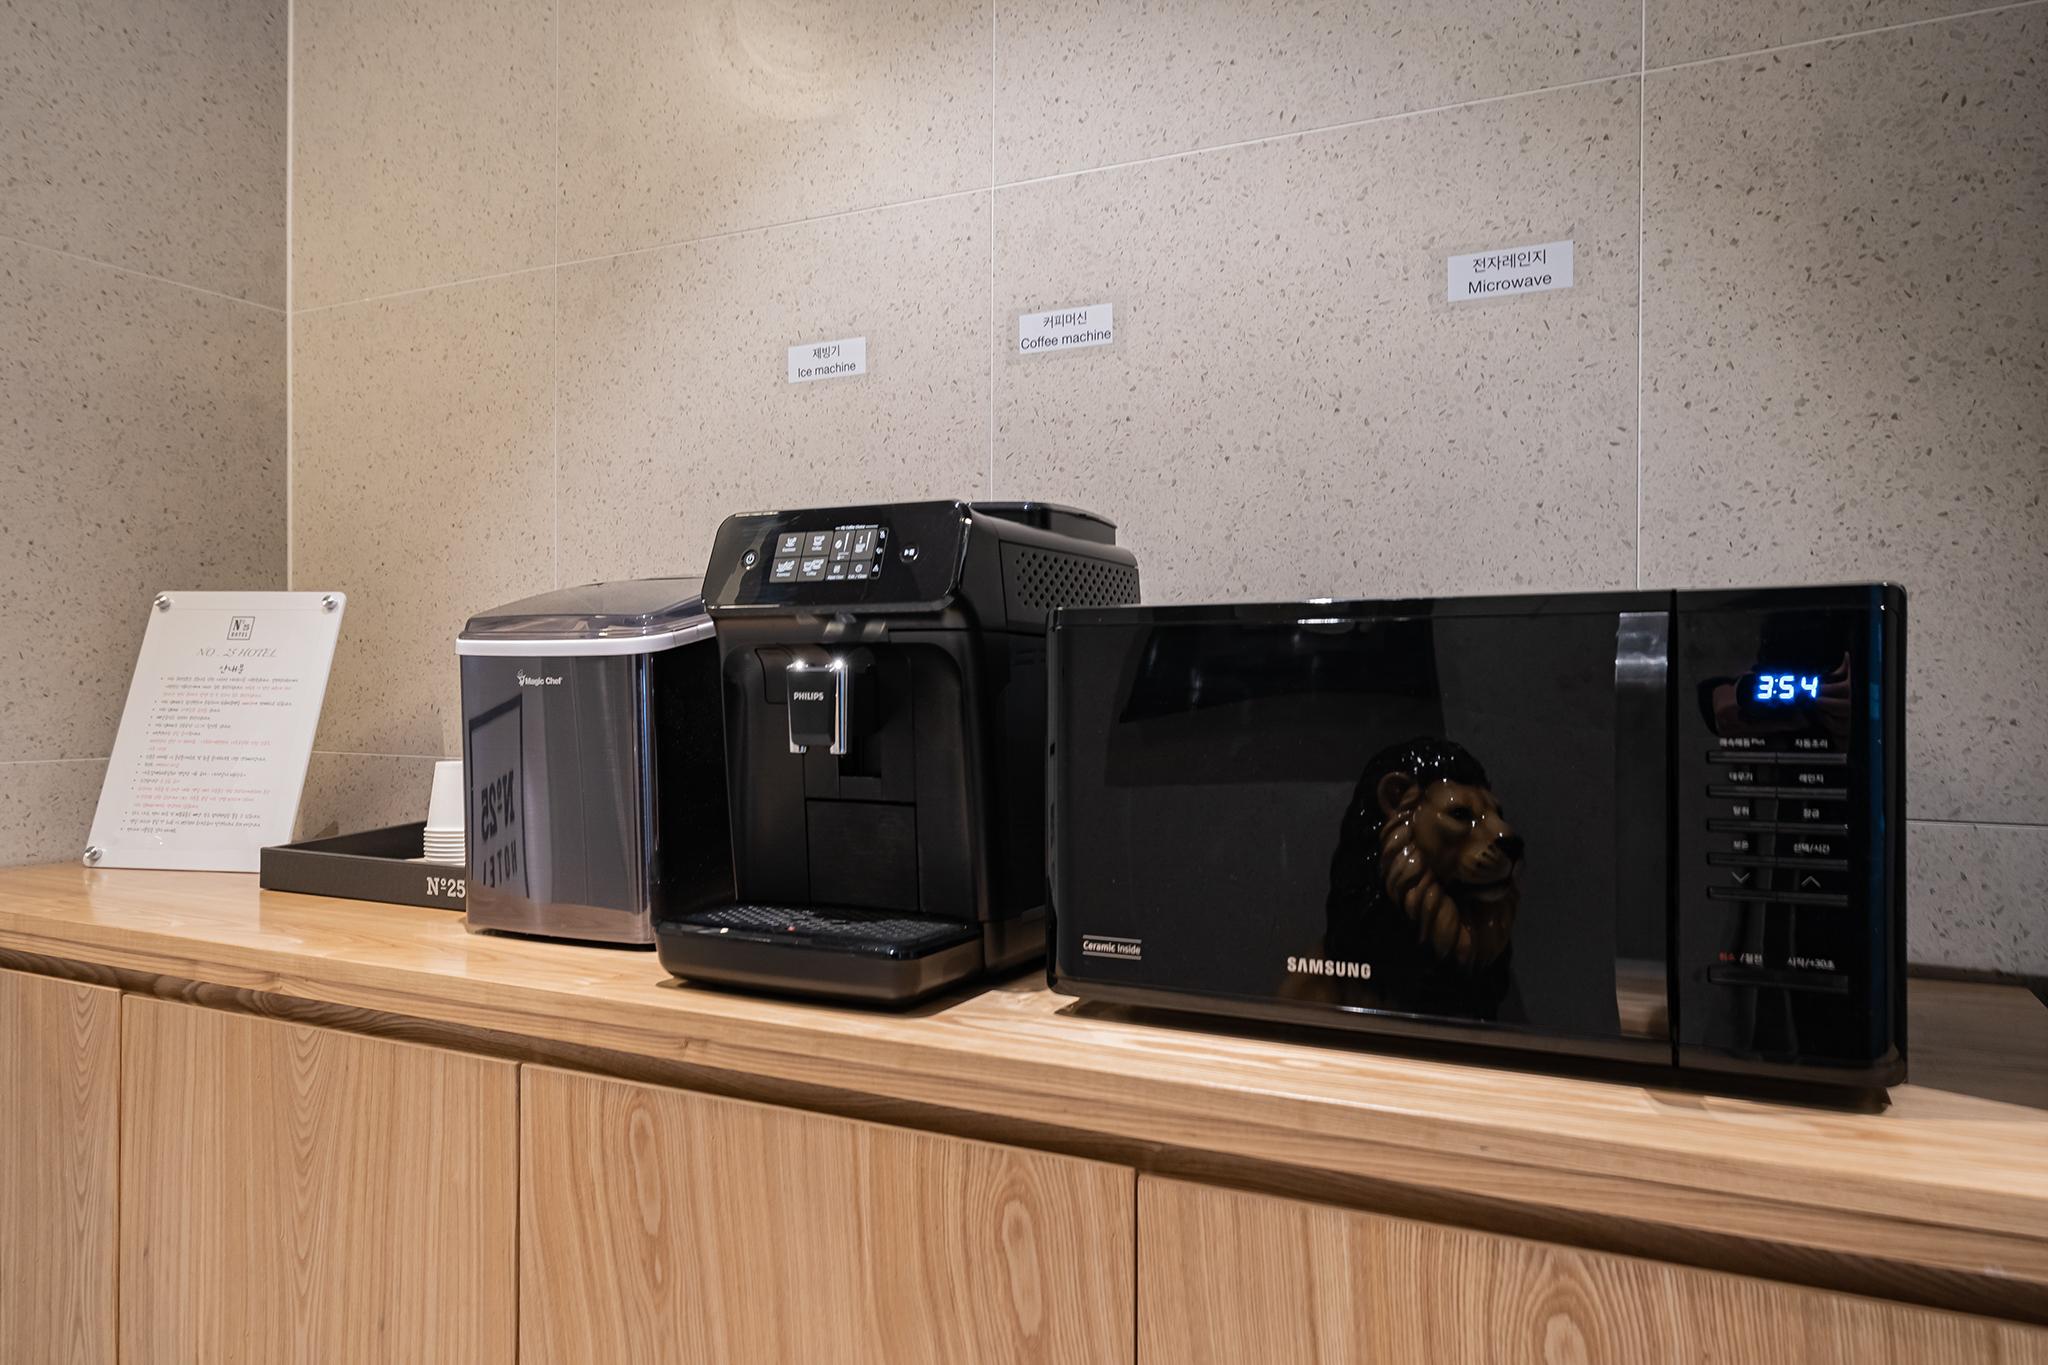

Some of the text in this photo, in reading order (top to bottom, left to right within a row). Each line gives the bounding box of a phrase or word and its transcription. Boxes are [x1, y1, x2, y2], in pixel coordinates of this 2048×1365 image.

[1473, 249, 1546, 273] 전자레인지
[1468, 274, 1552, 294] Microwave
[1043, 311, 1087, 328] 커피머신
[1020, 329, 1111, 350] Coffee machine
[812, 345, 840, 359] 제빙기
[797, 362, 856, 378] Ice machine
[525, 676, 562, 686] Magic Chef
[1757, 675, 1819, 700] 3:54
[793, 691, 824, 701] PHILIPS
[1083, 939, 1141, 956] Ceramic Inside
[1287, 956, 1371, 979] SAMSUNG
